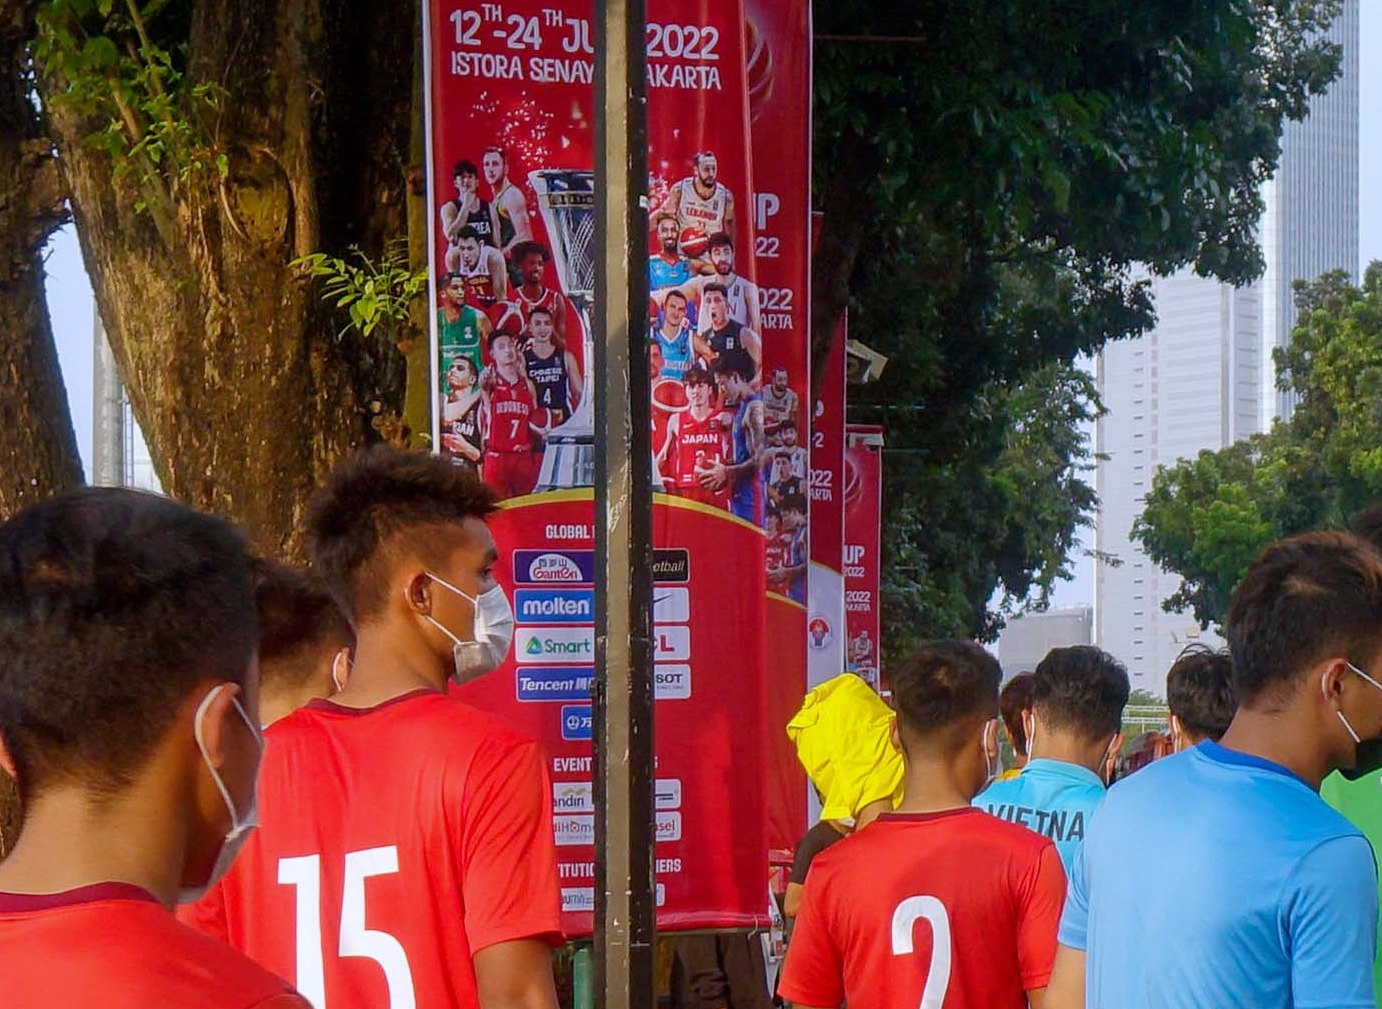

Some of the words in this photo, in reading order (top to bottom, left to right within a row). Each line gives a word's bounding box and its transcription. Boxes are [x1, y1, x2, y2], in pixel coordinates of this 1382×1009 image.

[646, 23, 720, 60] 2022
[451, 51, 524, 80] ISTORA
[681, 433, 719, 445] JAPAN
[546, 524, 590, 539] GLOBAL
[523, 596, 590, 616] molten
[544, 637, 591, 654] Smart
[520, 676, 573, 691] Tencent
[554, 757, 593, 772] EVENT
